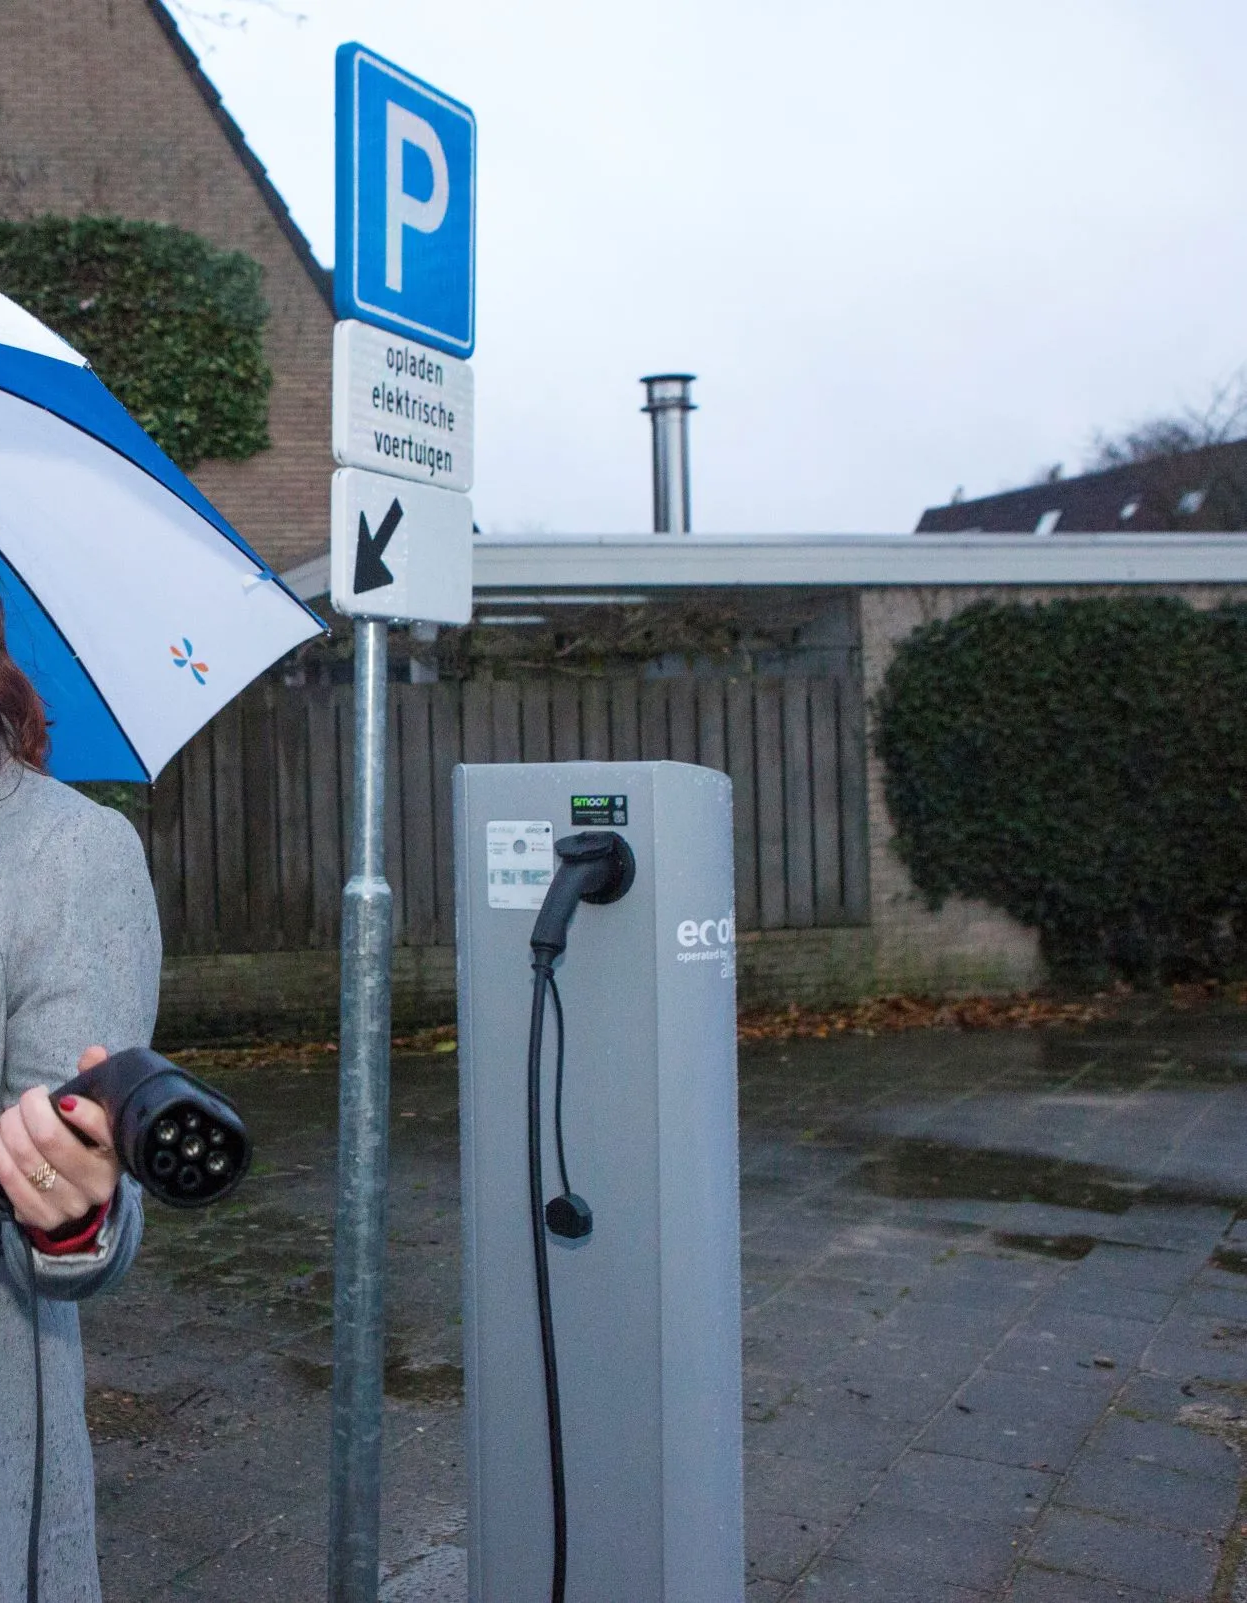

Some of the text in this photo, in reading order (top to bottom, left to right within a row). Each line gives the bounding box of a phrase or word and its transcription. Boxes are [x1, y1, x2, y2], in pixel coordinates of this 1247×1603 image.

[385, 99, 449, 293] P
[386, 346, 444, 386] opladen
[372, 381, 455, 432] elektrische
[374, 430, 453, 476] voertuigen
[677, 948, 719, 964] operated
